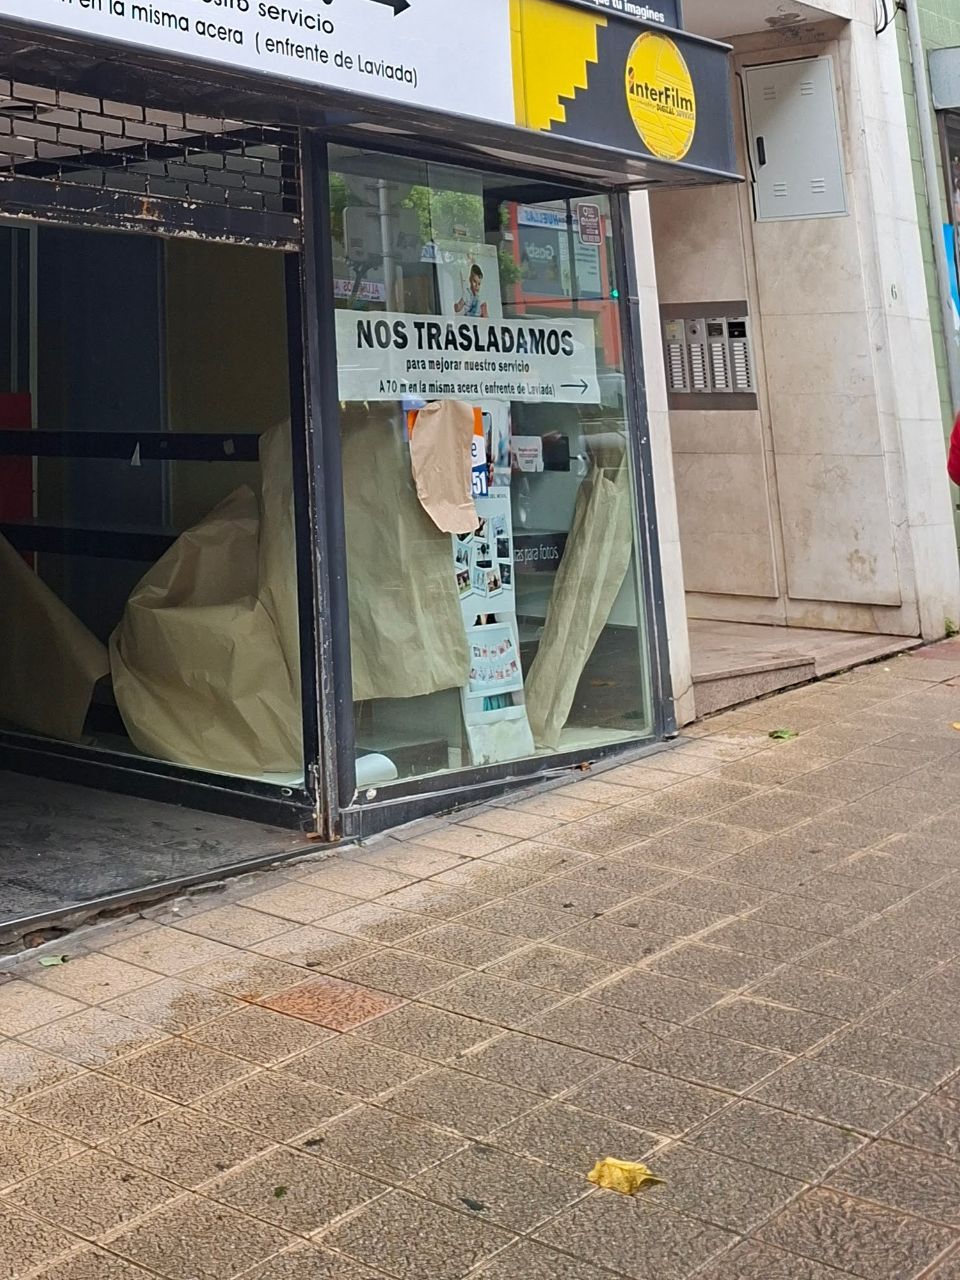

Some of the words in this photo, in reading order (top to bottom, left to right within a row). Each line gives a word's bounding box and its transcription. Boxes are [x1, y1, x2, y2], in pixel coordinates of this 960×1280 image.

[258, 0, 334, 34] servicio
[131, 3, 189, 32] misma
[195, 20, 244, 45] acera
[334, 49, 353, 70] de
[358, 54, 418, 88] Laviada)
[356, 319, 409, 350] NOS
[413, 321, 574, 356] TRASLADAMOS
[406, 359, 427, 372] para
[428, 357, 462, 373] mejorar
[464, 359, 496, 372] nuestro
[498, 359, 530, 373] servicio
[379, 380, 386, 394] A
[399, 382, 407, 394] m
[408, 383, 418, 394] en
[419, 380, 427, 394] la
[428, 381, 455, 394] misma
[456, 382, 478, 394] acera
[516, 381, 526, 394] de
